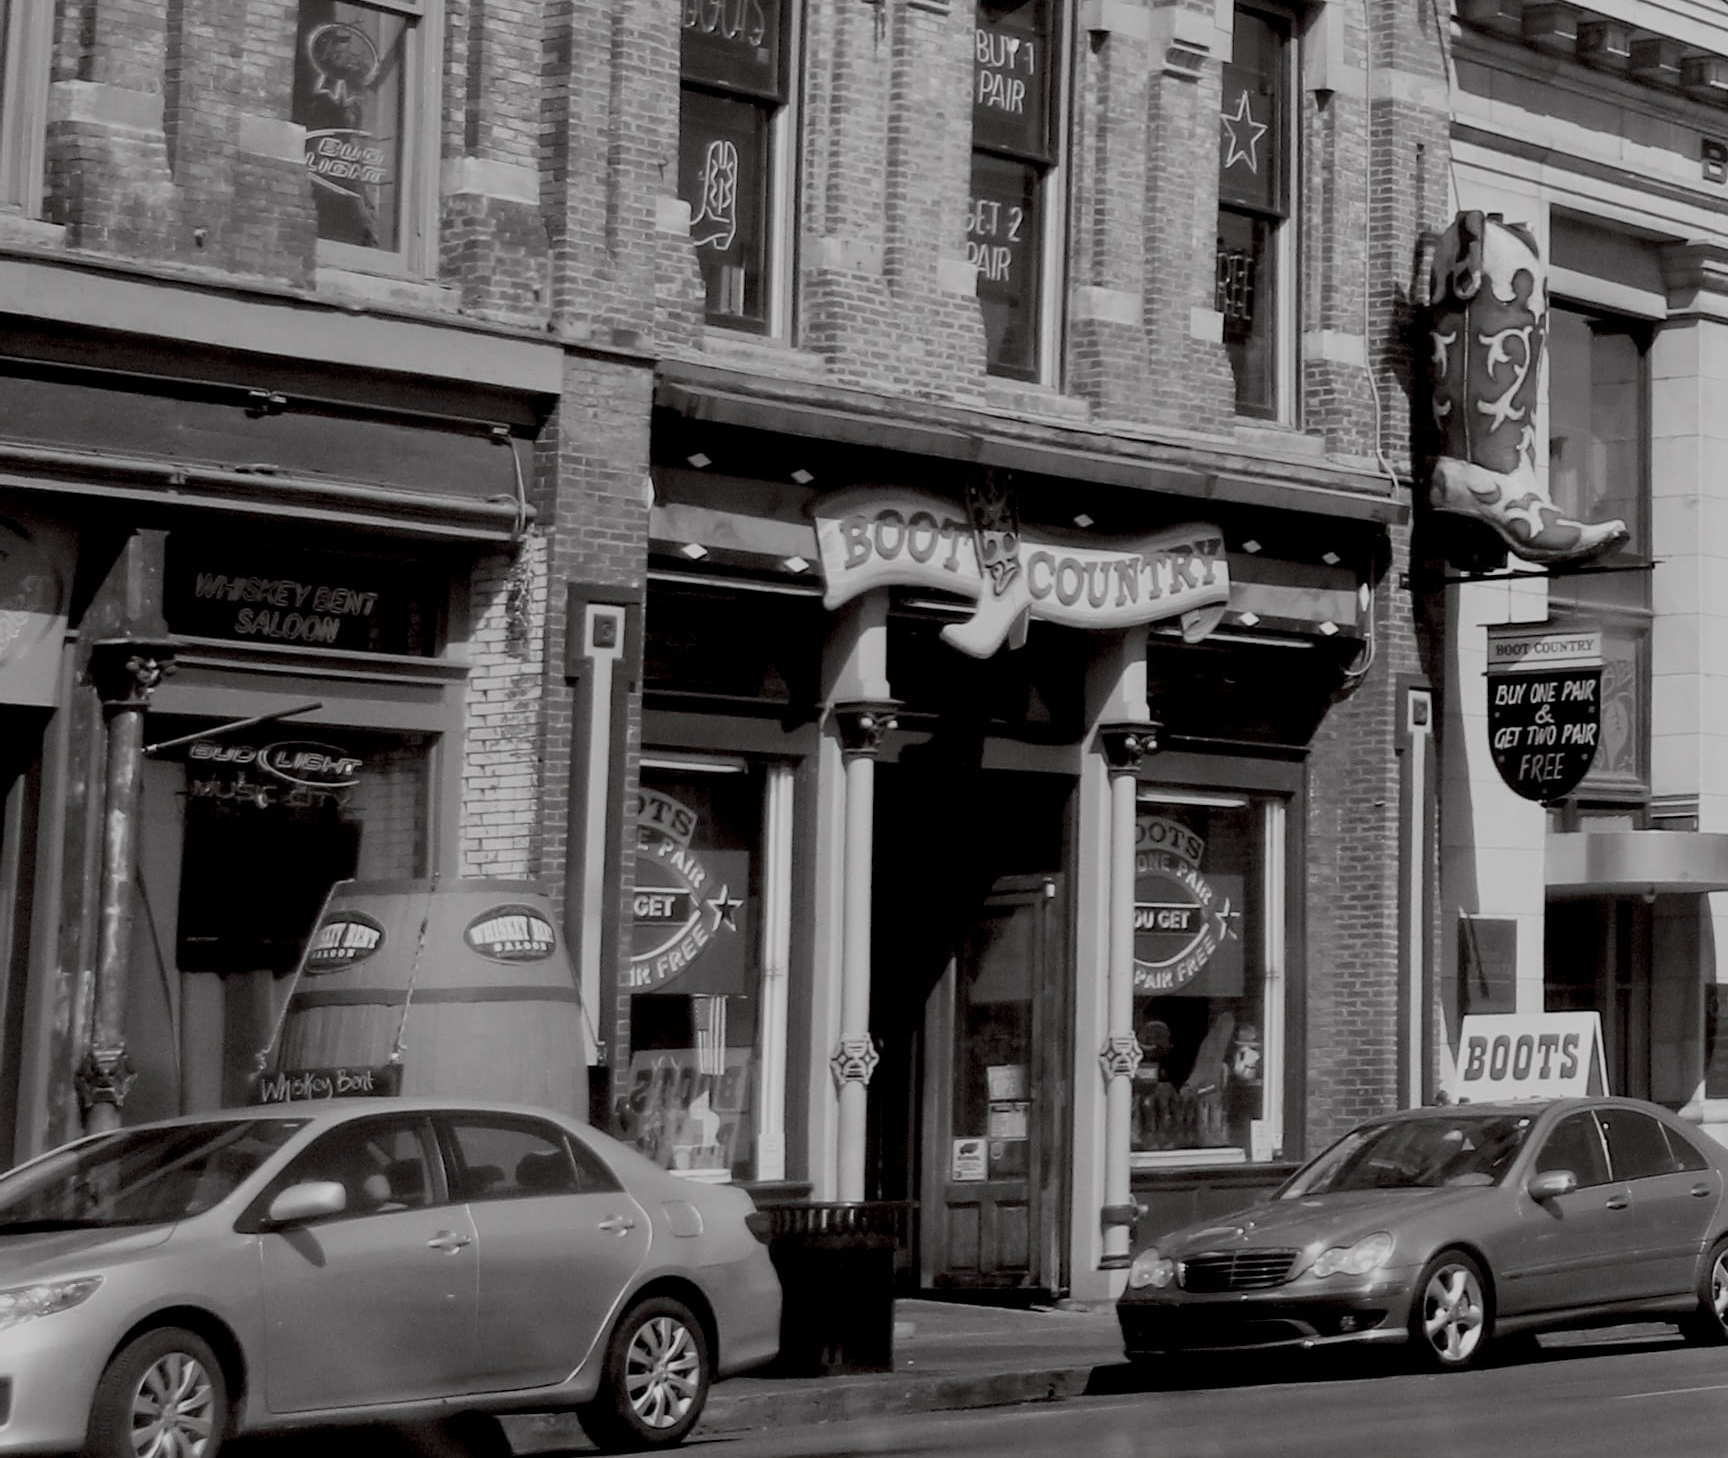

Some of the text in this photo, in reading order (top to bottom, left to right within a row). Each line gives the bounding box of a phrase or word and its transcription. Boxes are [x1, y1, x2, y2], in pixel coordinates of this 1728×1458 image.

[976, 29, 1034, 75] BUY 1
[977, 70, 1025, 114] PAIR
[305, 151, 388, 183] LIGHT
[319, 137, 384, 166] BUD
[1008, 206, 1022, 242] 2
[967, 240, 1012, 282] PAIR
[1217, 252, 1254, 321] REE
[840, 508, 1221, 608] BOOT COUNTRY
[194, 572, 379, 616] WHISKEY BENT
[234, 607, 341, 644] SALOON
[1495, 639, 1595, 657] BOOT COUNTRY
[1494, 679, 1597, 706] BUY ONE PAIR
[1534, 704, 1556, 724] &
[1494, 723, 1598, 749] GET TWO PAIR
[189, 744, 364, 777] BUD LIGHT
[1517, 752, 1566, 783] FREE
[637, 794, 693, 839] OTS
[1134, 821, 1204, 861] OOTS
[658, 840, 708, 889] PAIR
[1175, 866, 1213, 906] PAIR
[634, 895, 677, 919] GET
[1134, 909, 1191, 929] OU GET
[493, 941, 548, 953] SALOON
[656, 922, 711, 979] FREE
[1134, 934, 1217, 990] PAIR FREE
[1463, 1032, 1581, 1082] BOOTS
